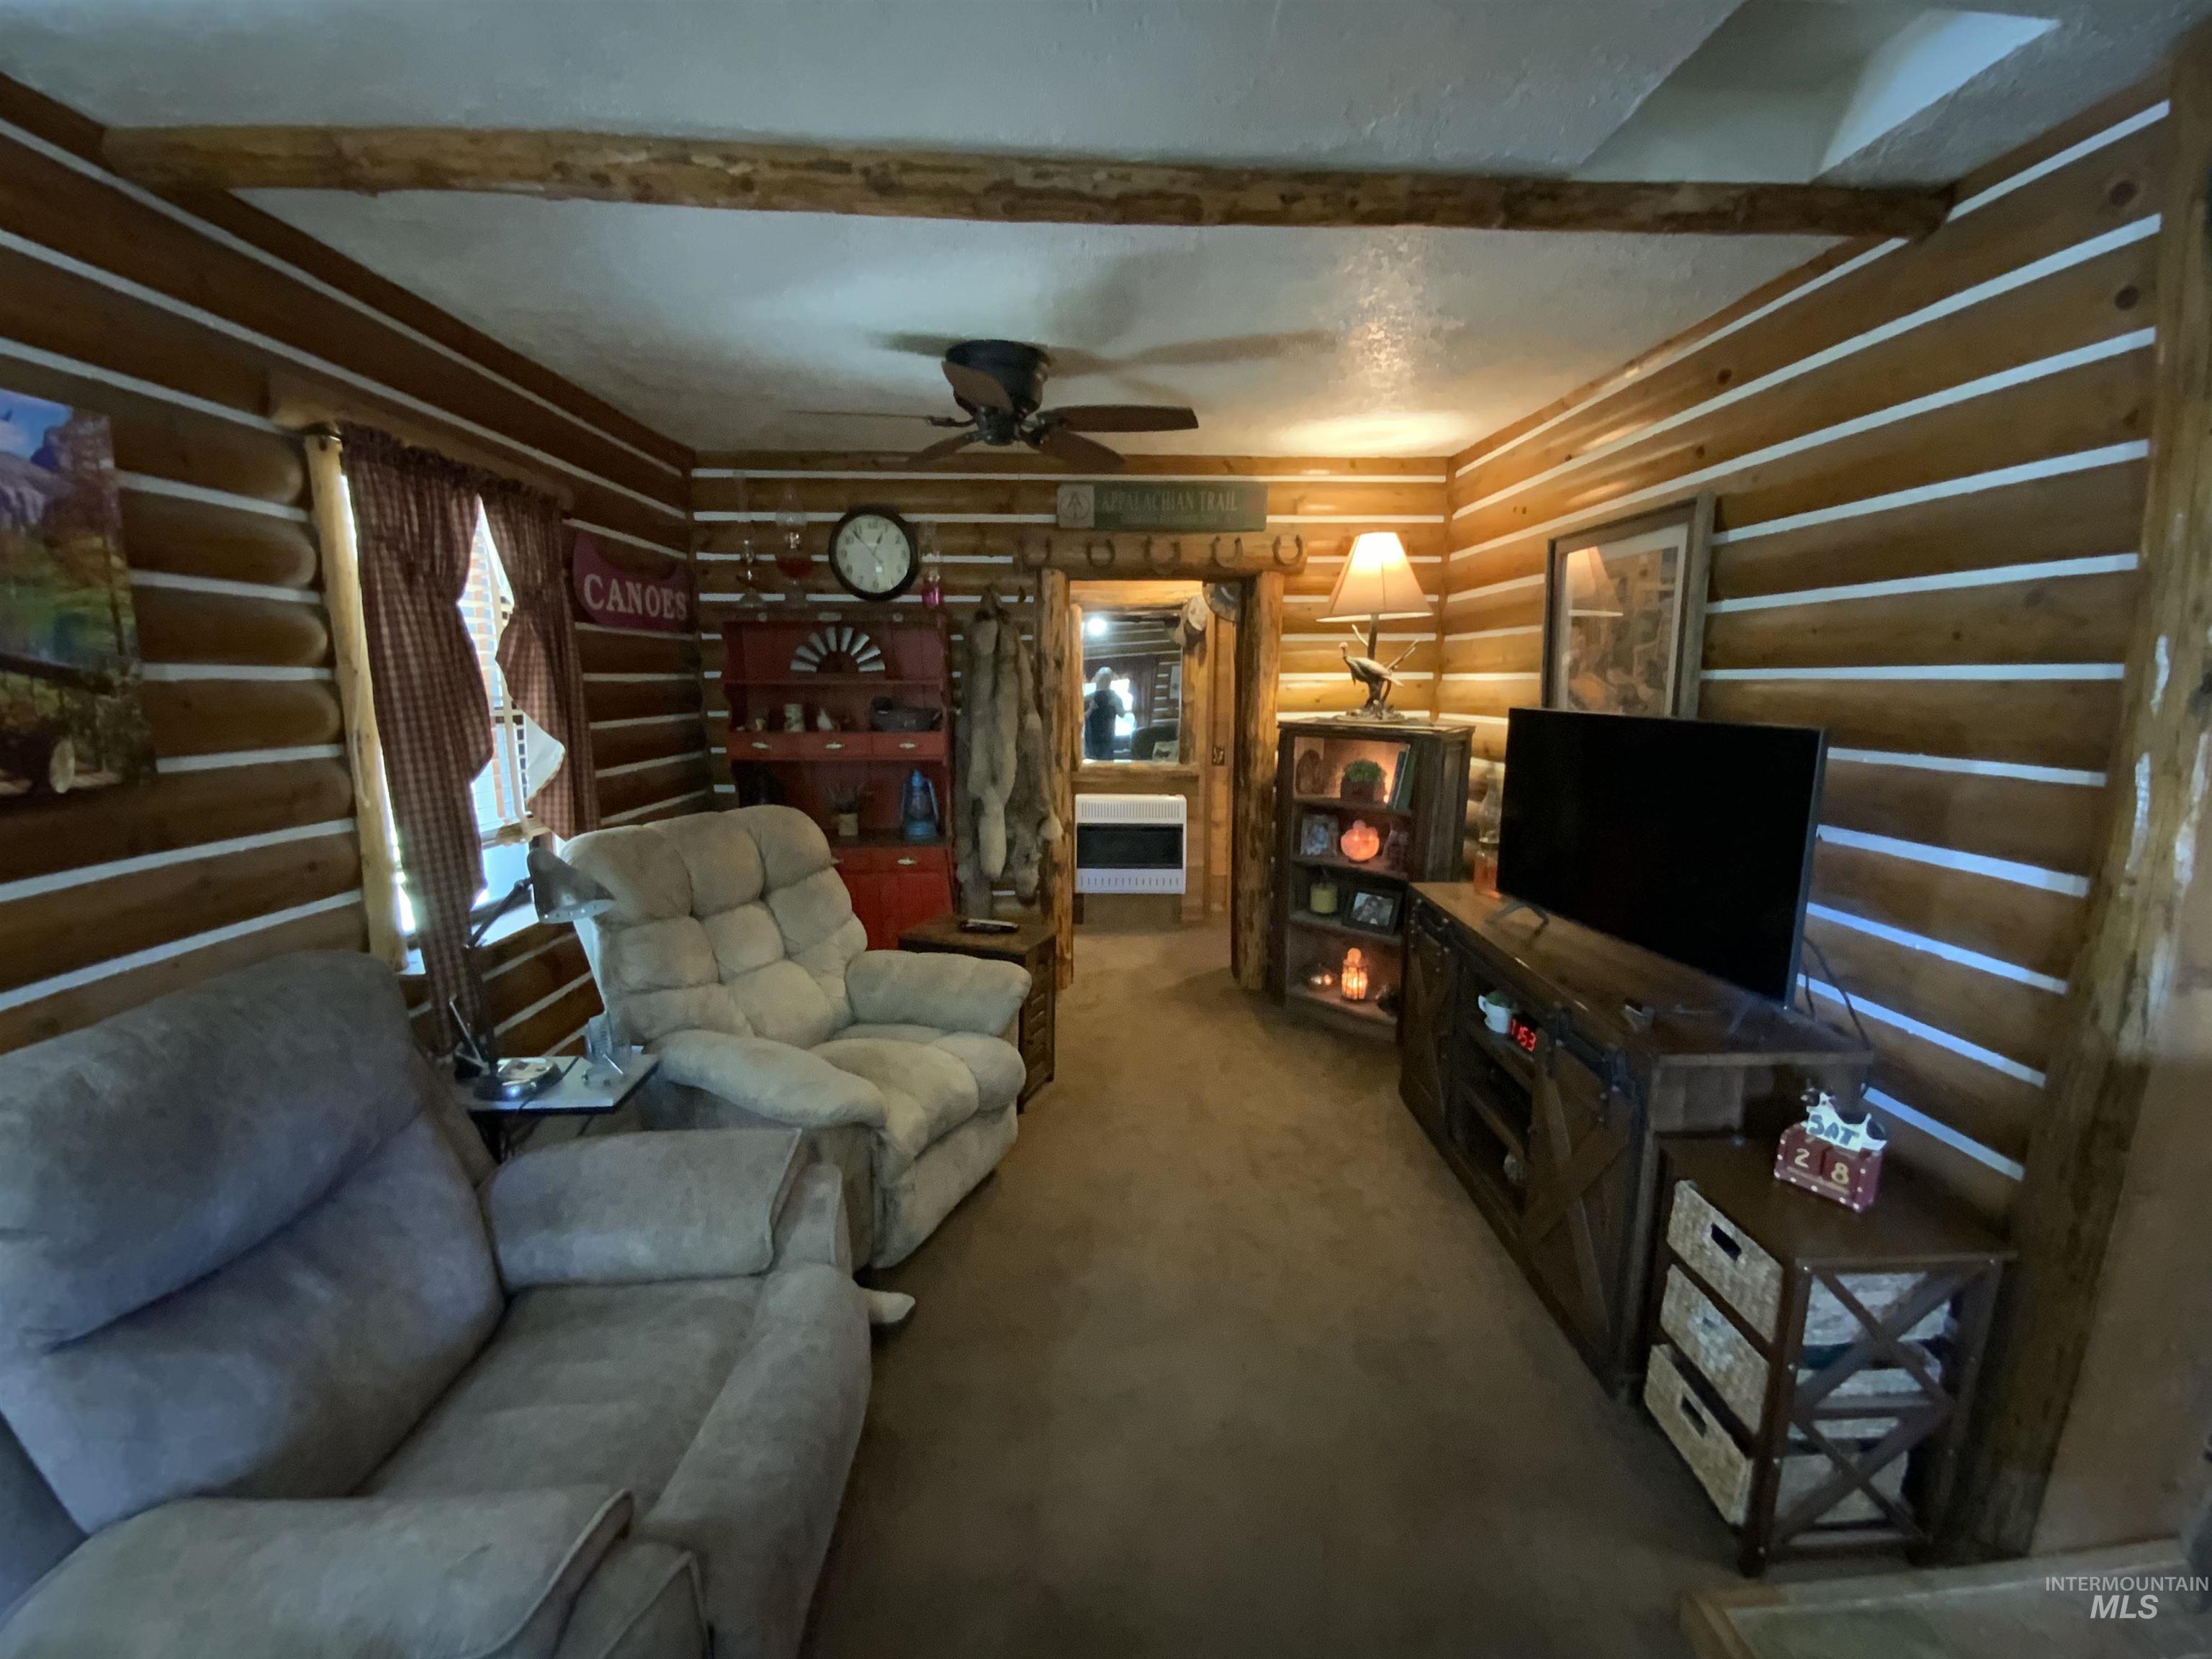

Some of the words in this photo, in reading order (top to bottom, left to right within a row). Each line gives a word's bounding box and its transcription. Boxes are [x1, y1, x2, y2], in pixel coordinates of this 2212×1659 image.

[1199, 490, 1238, 512] TRAIL
[583, 573, 688, 621] CANOES
[1808, 1114, 1861, 1146] SAT
[1794, 1148, 1811, 1169] 2
[1830, 1161, 1850, 1184] 8
